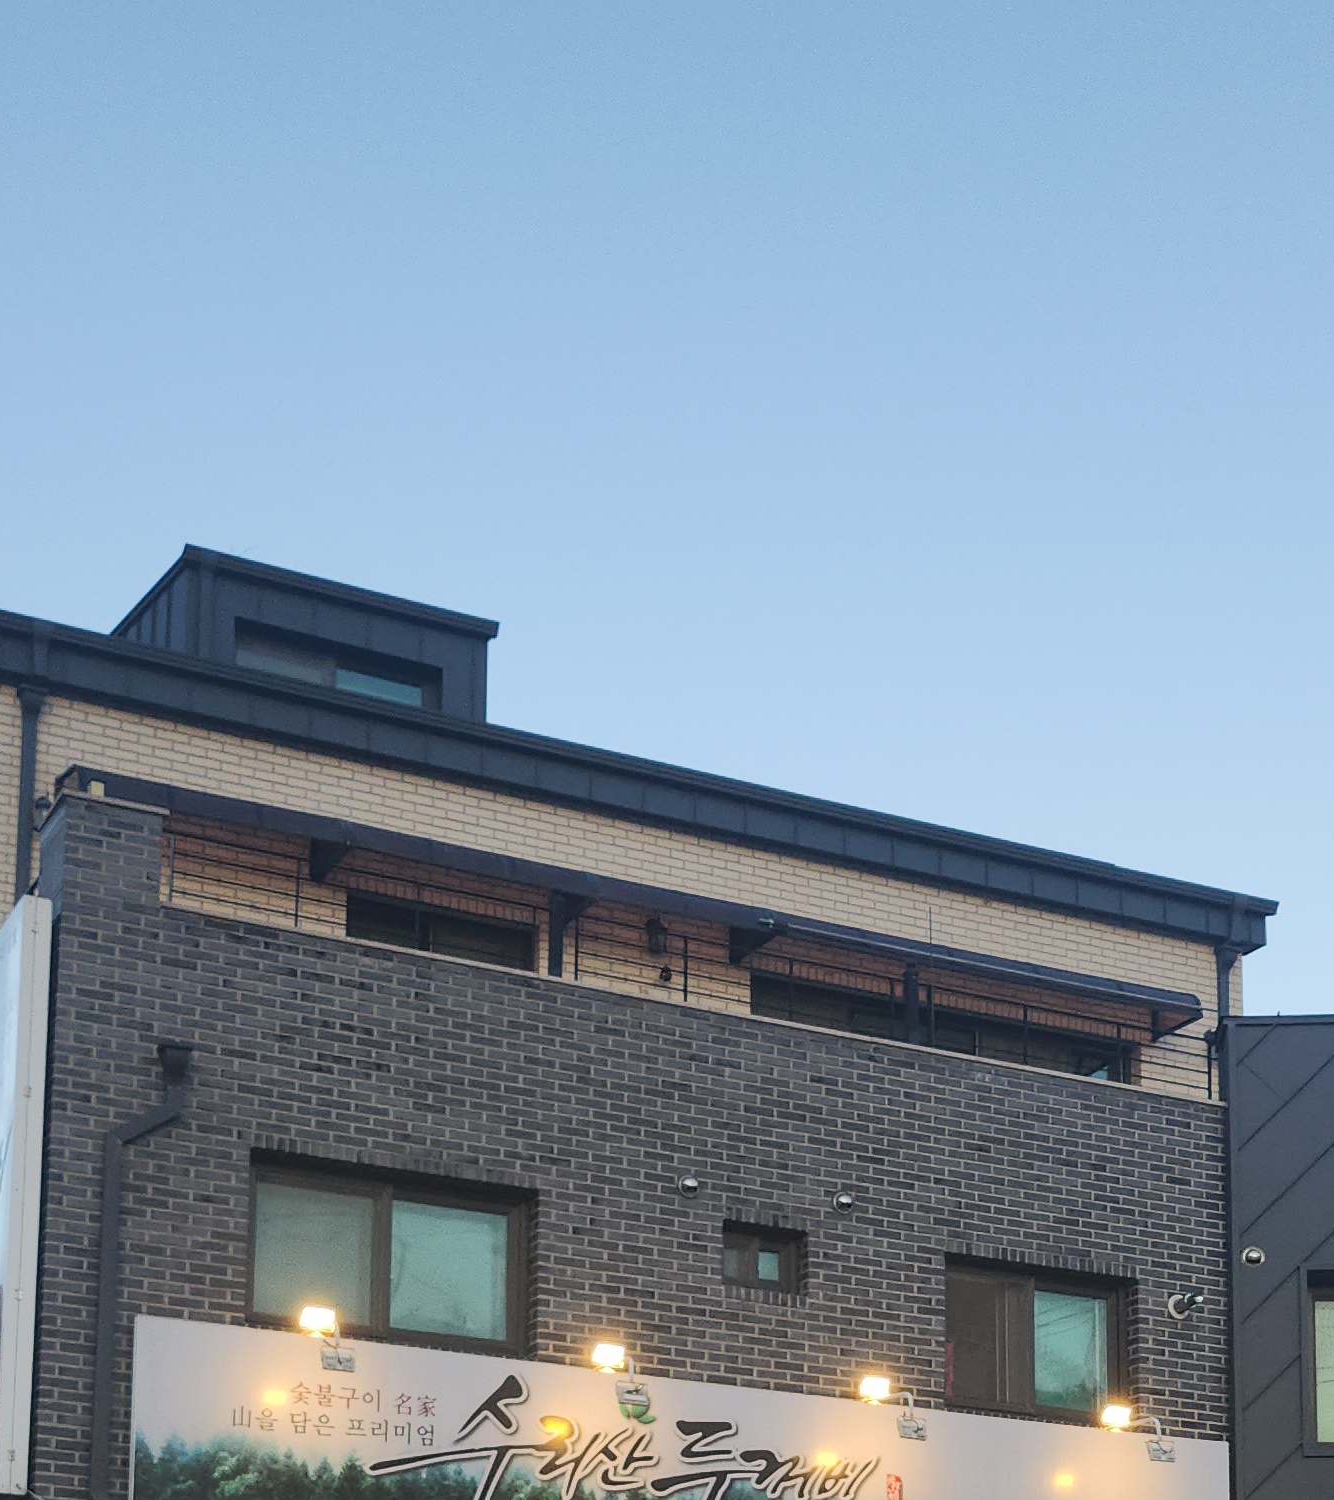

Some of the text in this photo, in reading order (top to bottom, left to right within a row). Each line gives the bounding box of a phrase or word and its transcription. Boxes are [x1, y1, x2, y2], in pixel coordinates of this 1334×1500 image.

[289, 1380, 438, 1419] 숯불구이 名家
[232, 1406, 437, 1447] 山을 담은 프리미엄
